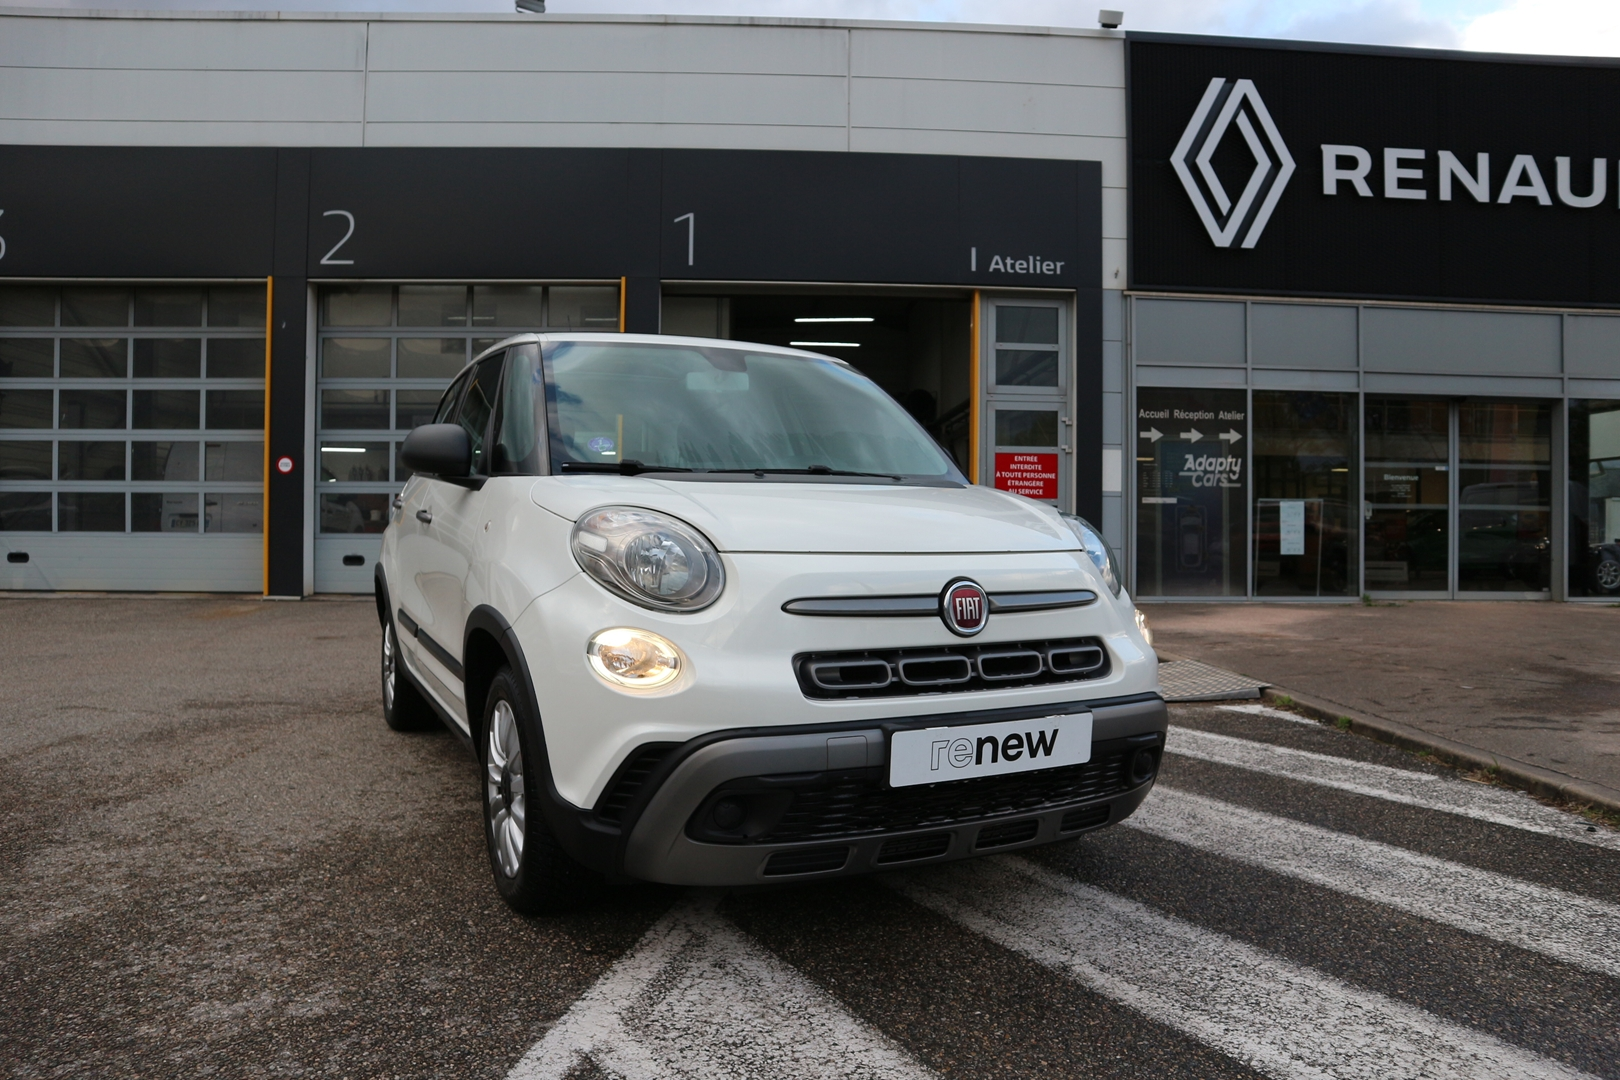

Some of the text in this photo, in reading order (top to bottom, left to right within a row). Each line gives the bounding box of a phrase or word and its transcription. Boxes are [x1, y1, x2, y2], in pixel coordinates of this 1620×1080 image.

[1320, 144, 1620, 208] RENAU
[319, 209, 355, 265] 2
[673, 212, 695, 266] 1
[989, 254, 1065, 275] Atelier
[1138, 409, 1245, 421] Accueil Réception Atelier
[1183, 454, 1242, 480] Adapty
[1191, 471, 1229, 488] Cars
[955, 597, 979, 620] FIAT
[930, 729, 1059, 771] renew
